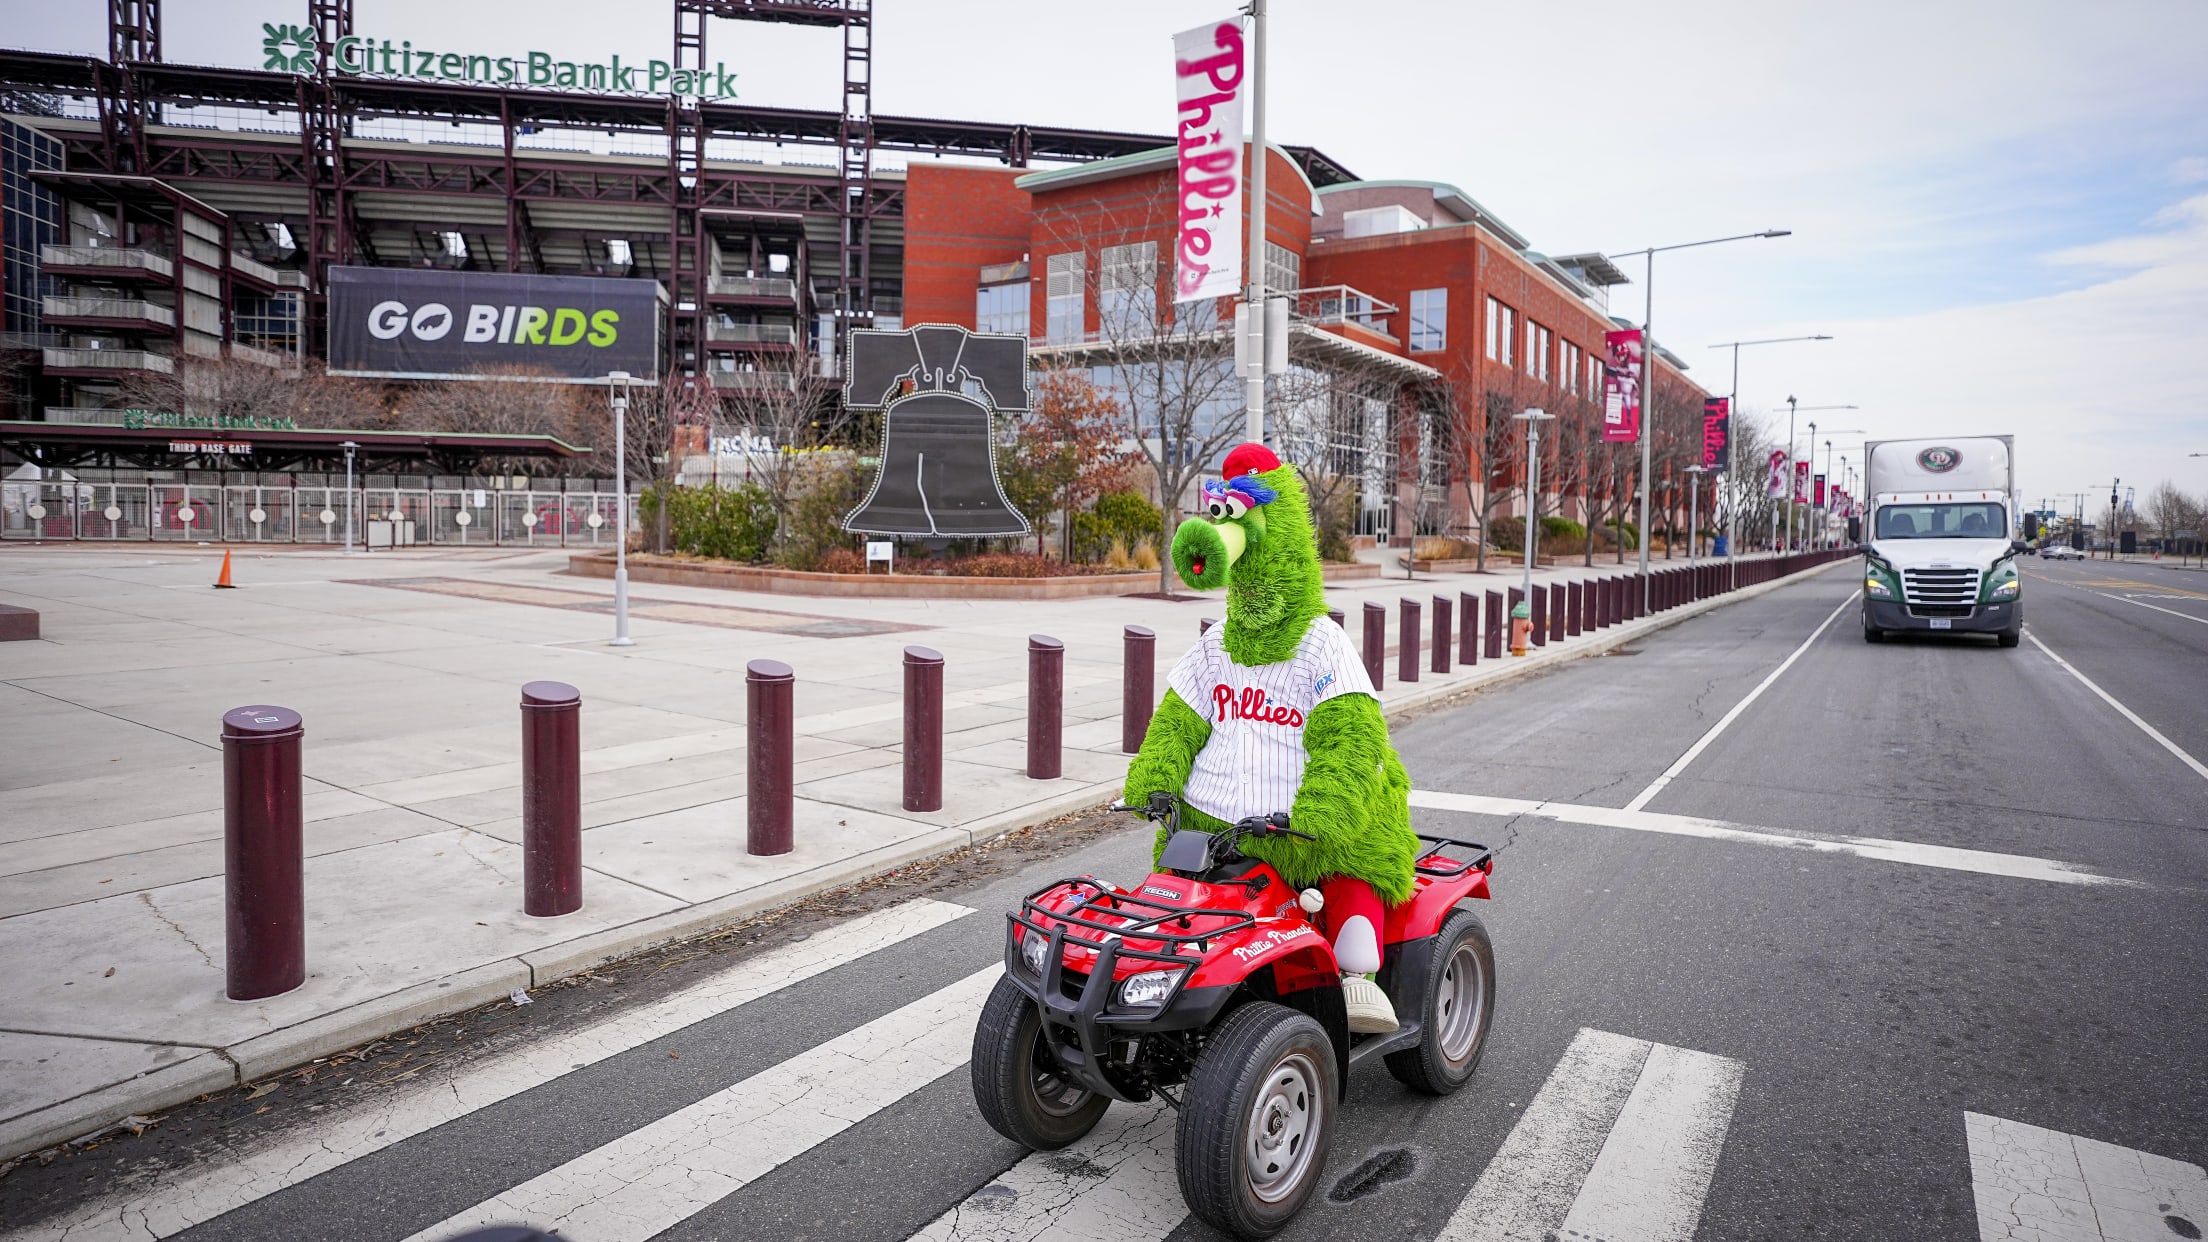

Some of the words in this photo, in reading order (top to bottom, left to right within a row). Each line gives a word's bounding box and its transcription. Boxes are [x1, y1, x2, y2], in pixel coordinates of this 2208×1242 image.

[334, 37, 514, 83] Citizens
[527, 51, 633, 91] Bank
[648, 60, 739, 98] Park
[1176, 22, 1244, 294] Phillies
[367, 300, 454, 341] GO
[463, 304, 621, 348] BIRDS
[169, 442, 197, 453] THIRD
[200, 443, 225, 454] BASE
[228, 443, 253, 455] GATE
[1703, 397, 1729, 471] Phillie
[1213, 683, 1304, 728] Phllies
[1314, 672, 1334, 696] IBX
[1144, 886, 1178, 900] RECON
[1232, 941, 1274, 962] Phillie
[1267, 918, 1316, 945] Phanatic
